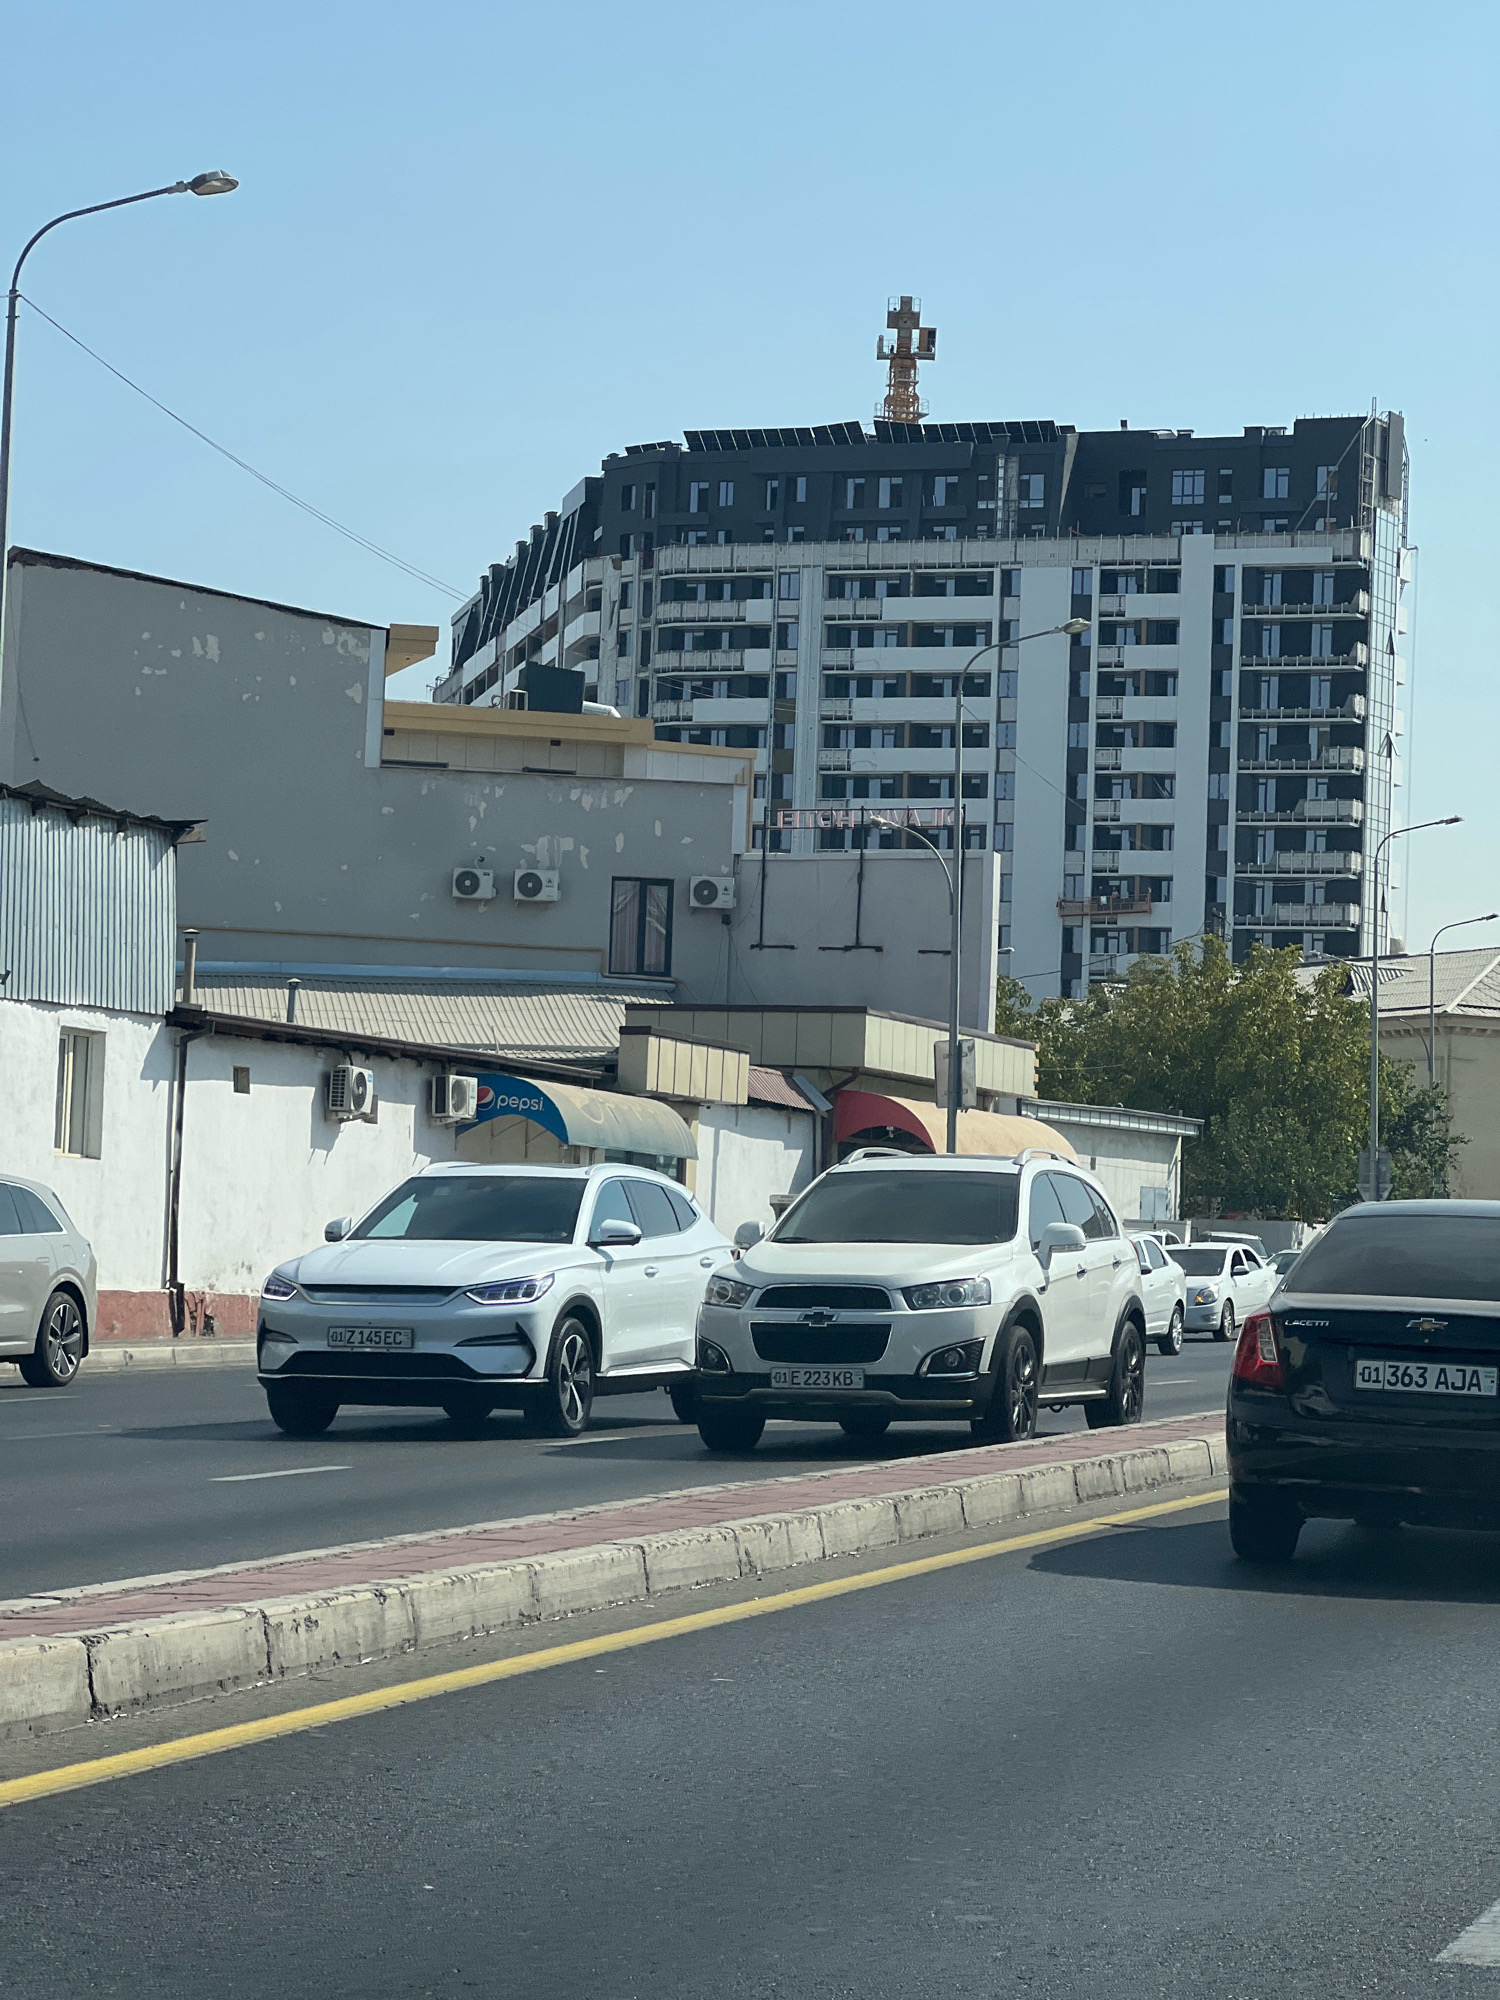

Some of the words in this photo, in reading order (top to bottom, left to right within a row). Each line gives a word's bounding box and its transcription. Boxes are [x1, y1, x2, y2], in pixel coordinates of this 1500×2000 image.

[496, 1095, 544, 1112] pepsi
[1284, 1319, 1330, 1327] LACETTI
[330, 1331, 344, 1343] 01
[773, 1372, 788, 1384] 01
[1360, 1366, 1382, 1384] 01
[1386, 1364, 1428, 1389] 363
[1434, 1367, 1482, 1392] AJA
